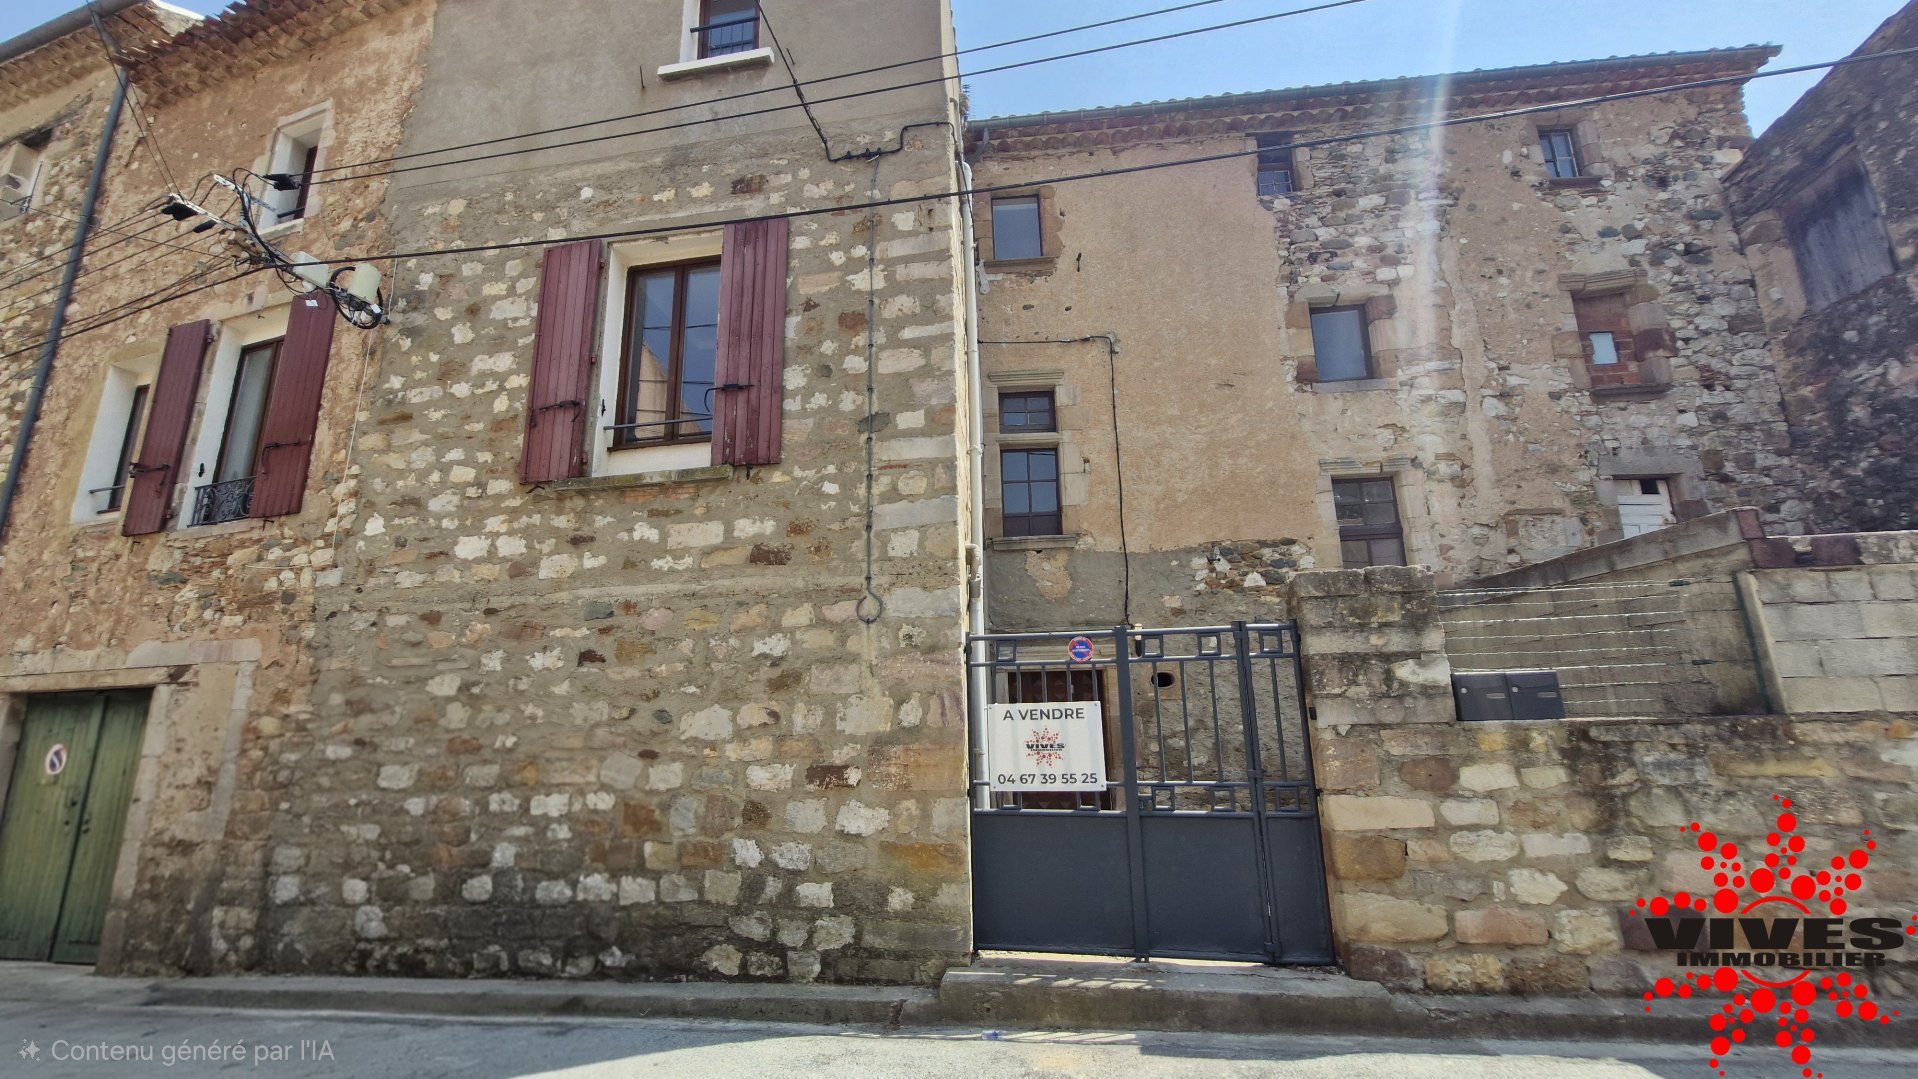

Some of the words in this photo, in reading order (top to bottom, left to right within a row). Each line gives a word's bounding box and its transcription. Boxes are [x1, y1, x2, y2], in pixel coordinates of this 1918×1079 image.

[1003, 710, 1015, 721] A
[1018, 708, 1084, 720] VENDRE
[997, 773, 1016, 785] 04
[1019, 773, 1036, 784] 67
[1040, 773, 1057, 784] 39
[1061, 773, 1078, 784] 55
[1081, 772, 1098, 784] 25
